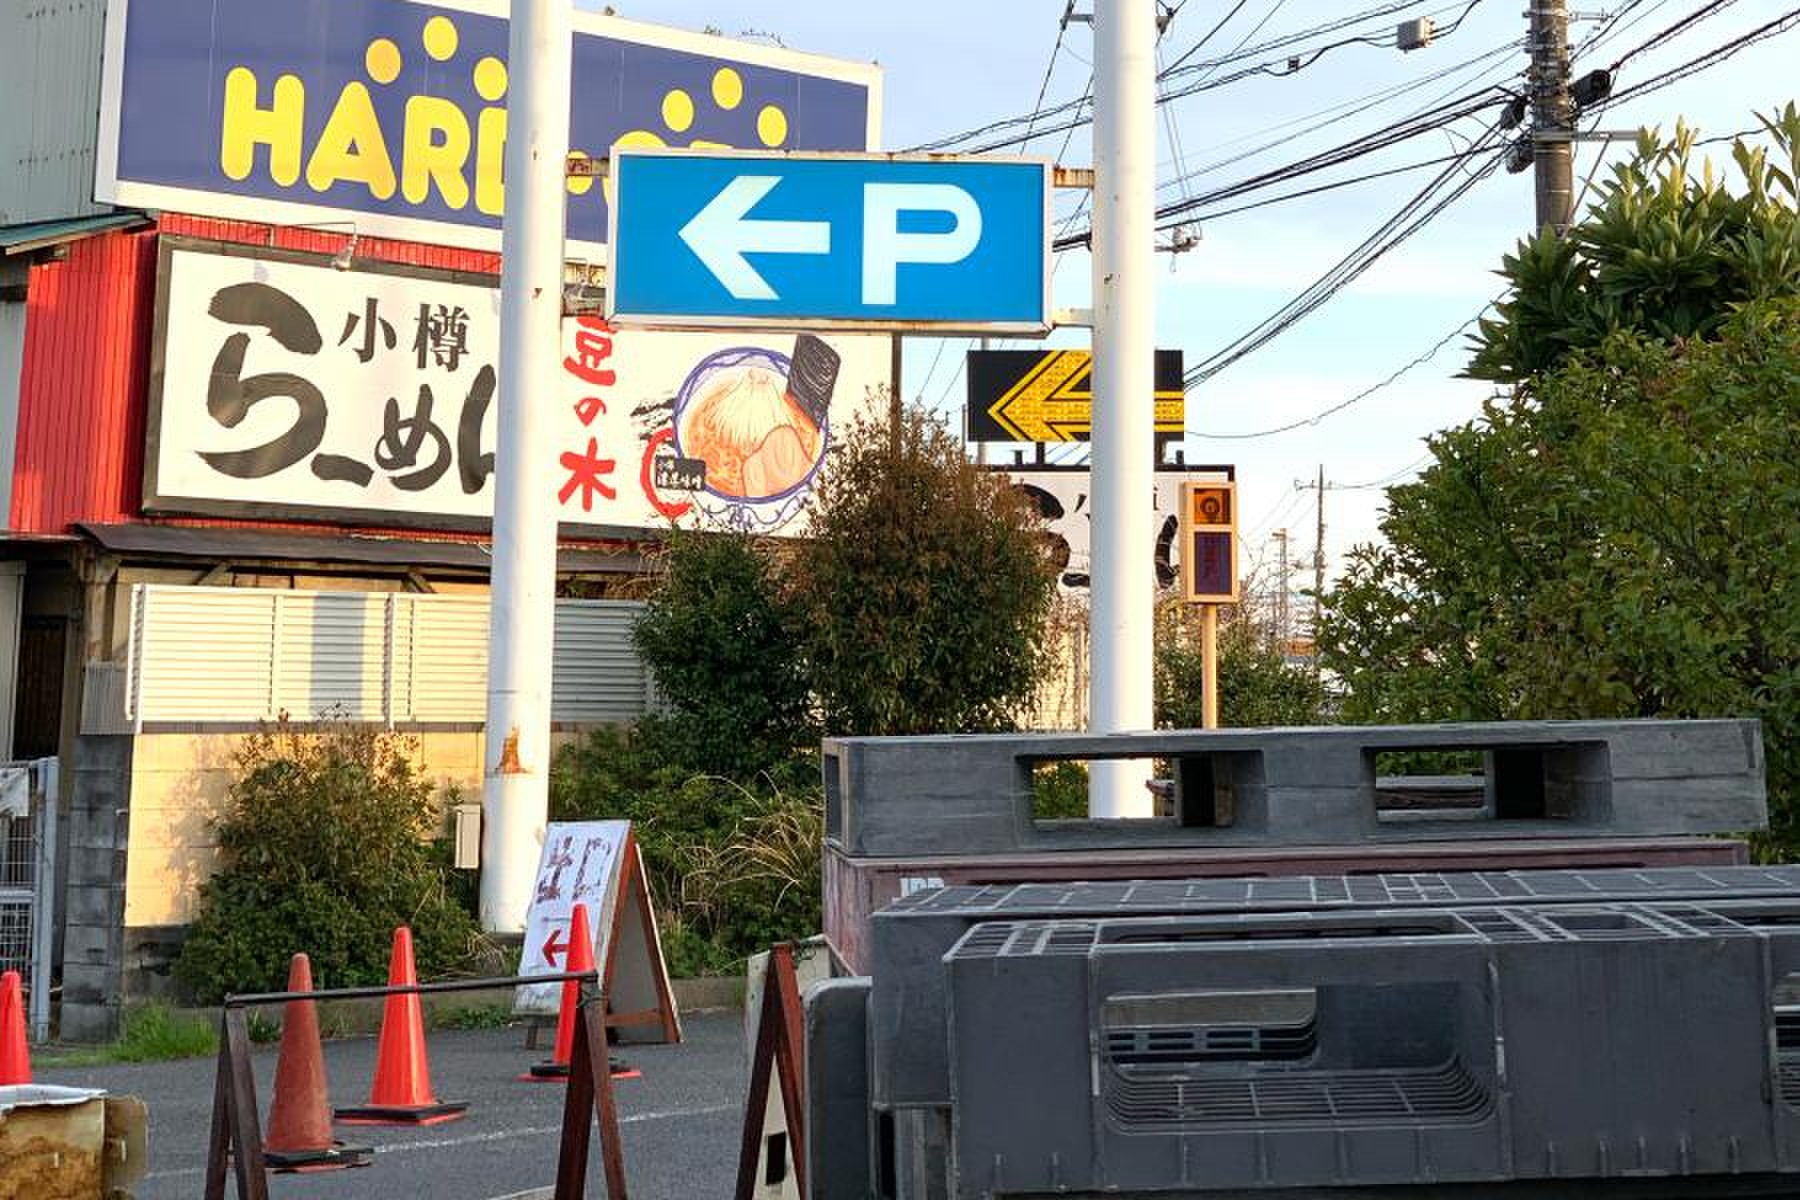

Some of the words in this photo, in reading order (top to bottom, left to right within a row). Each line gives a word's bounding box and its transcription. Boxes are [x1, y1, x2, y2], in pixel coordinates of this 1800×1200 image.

[861, 182, 983, 305] P
[337, 297, 471, 373] 小樽
[558, 316, 618, 513] 豆の木
